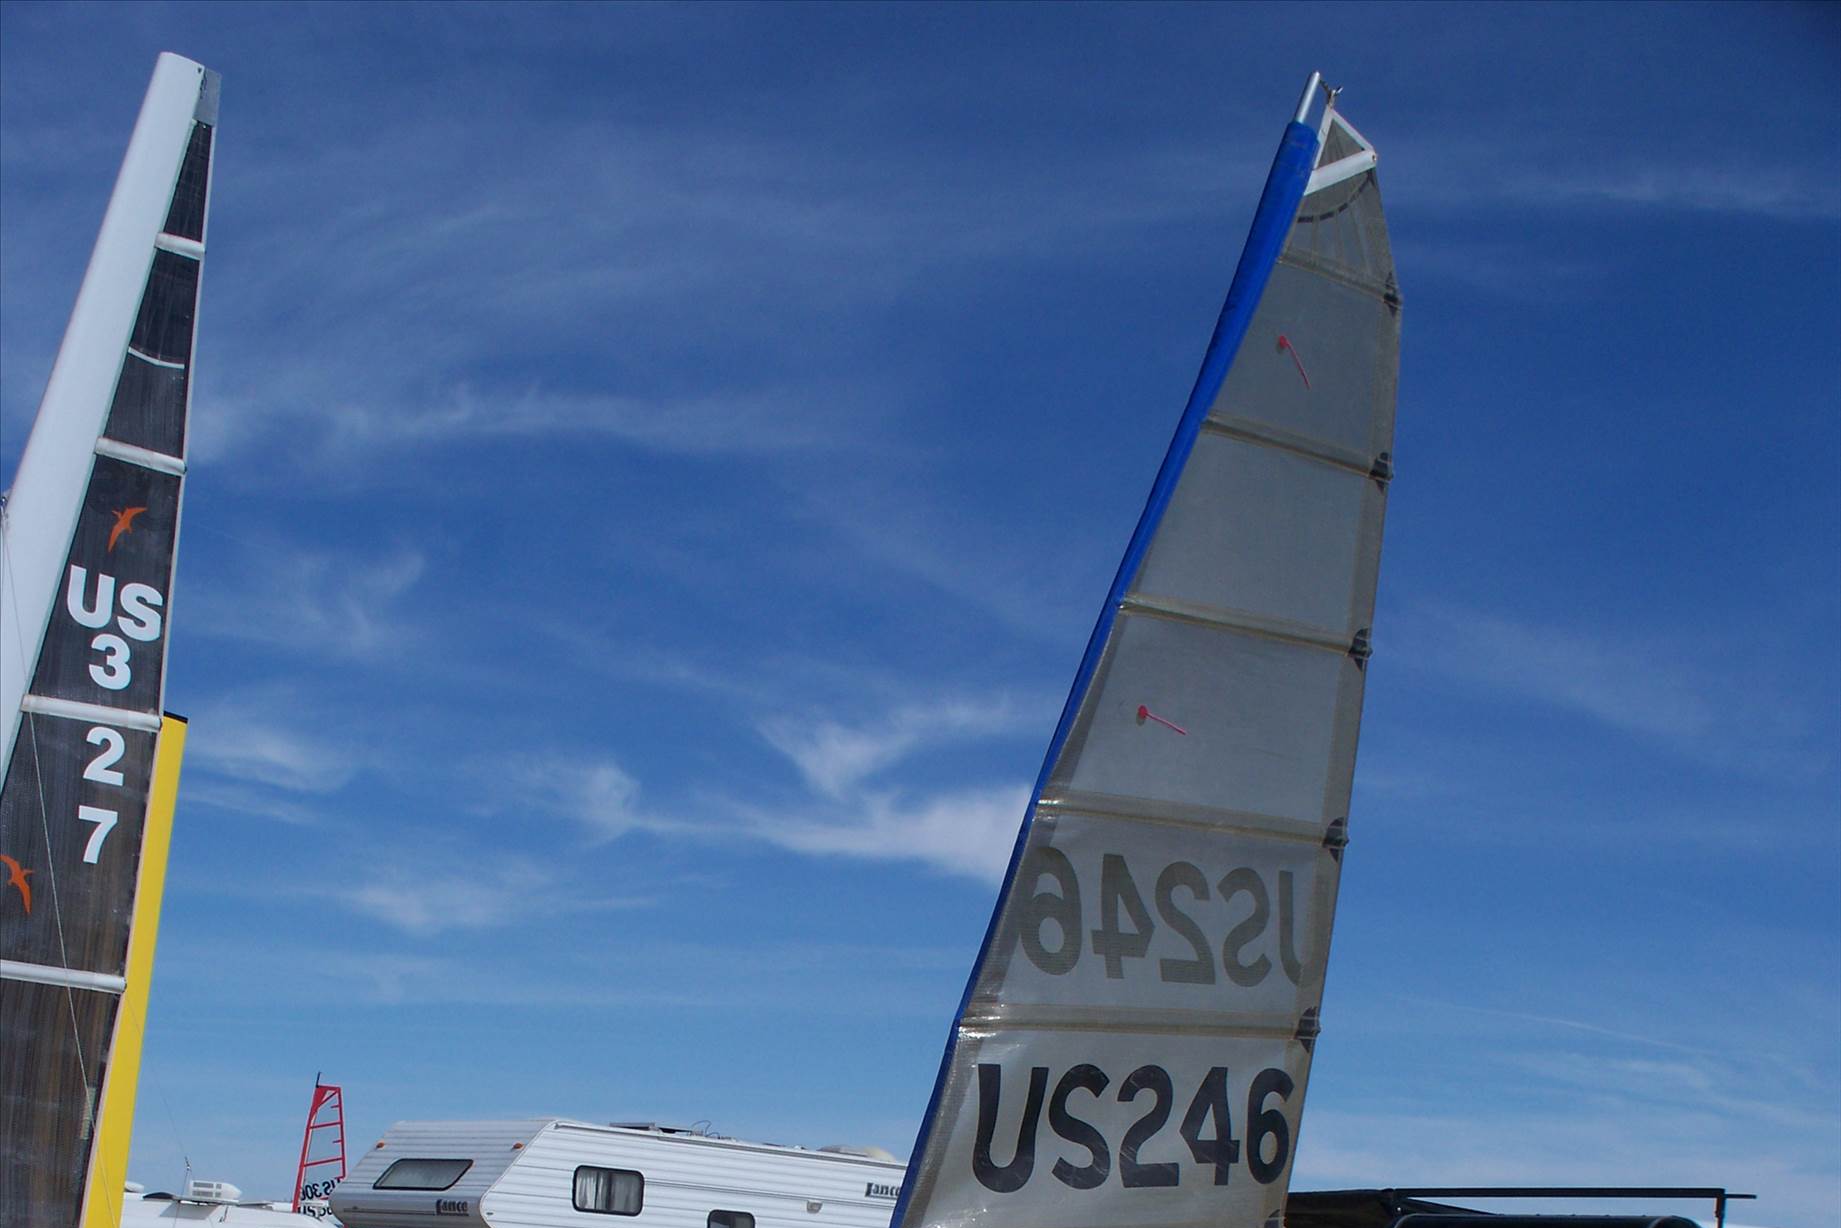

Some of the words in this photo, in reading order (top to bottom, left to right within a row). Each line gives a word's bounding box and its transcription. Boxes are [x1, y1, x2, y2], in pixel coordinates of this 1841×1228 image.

[67, 564, 164, 642] US
[88, 633, 132, 690] 3
[83, 726, 126, 787] 2
[78, 804, 119, 865] 7
[972, 1063, 1295, 1194] US246
